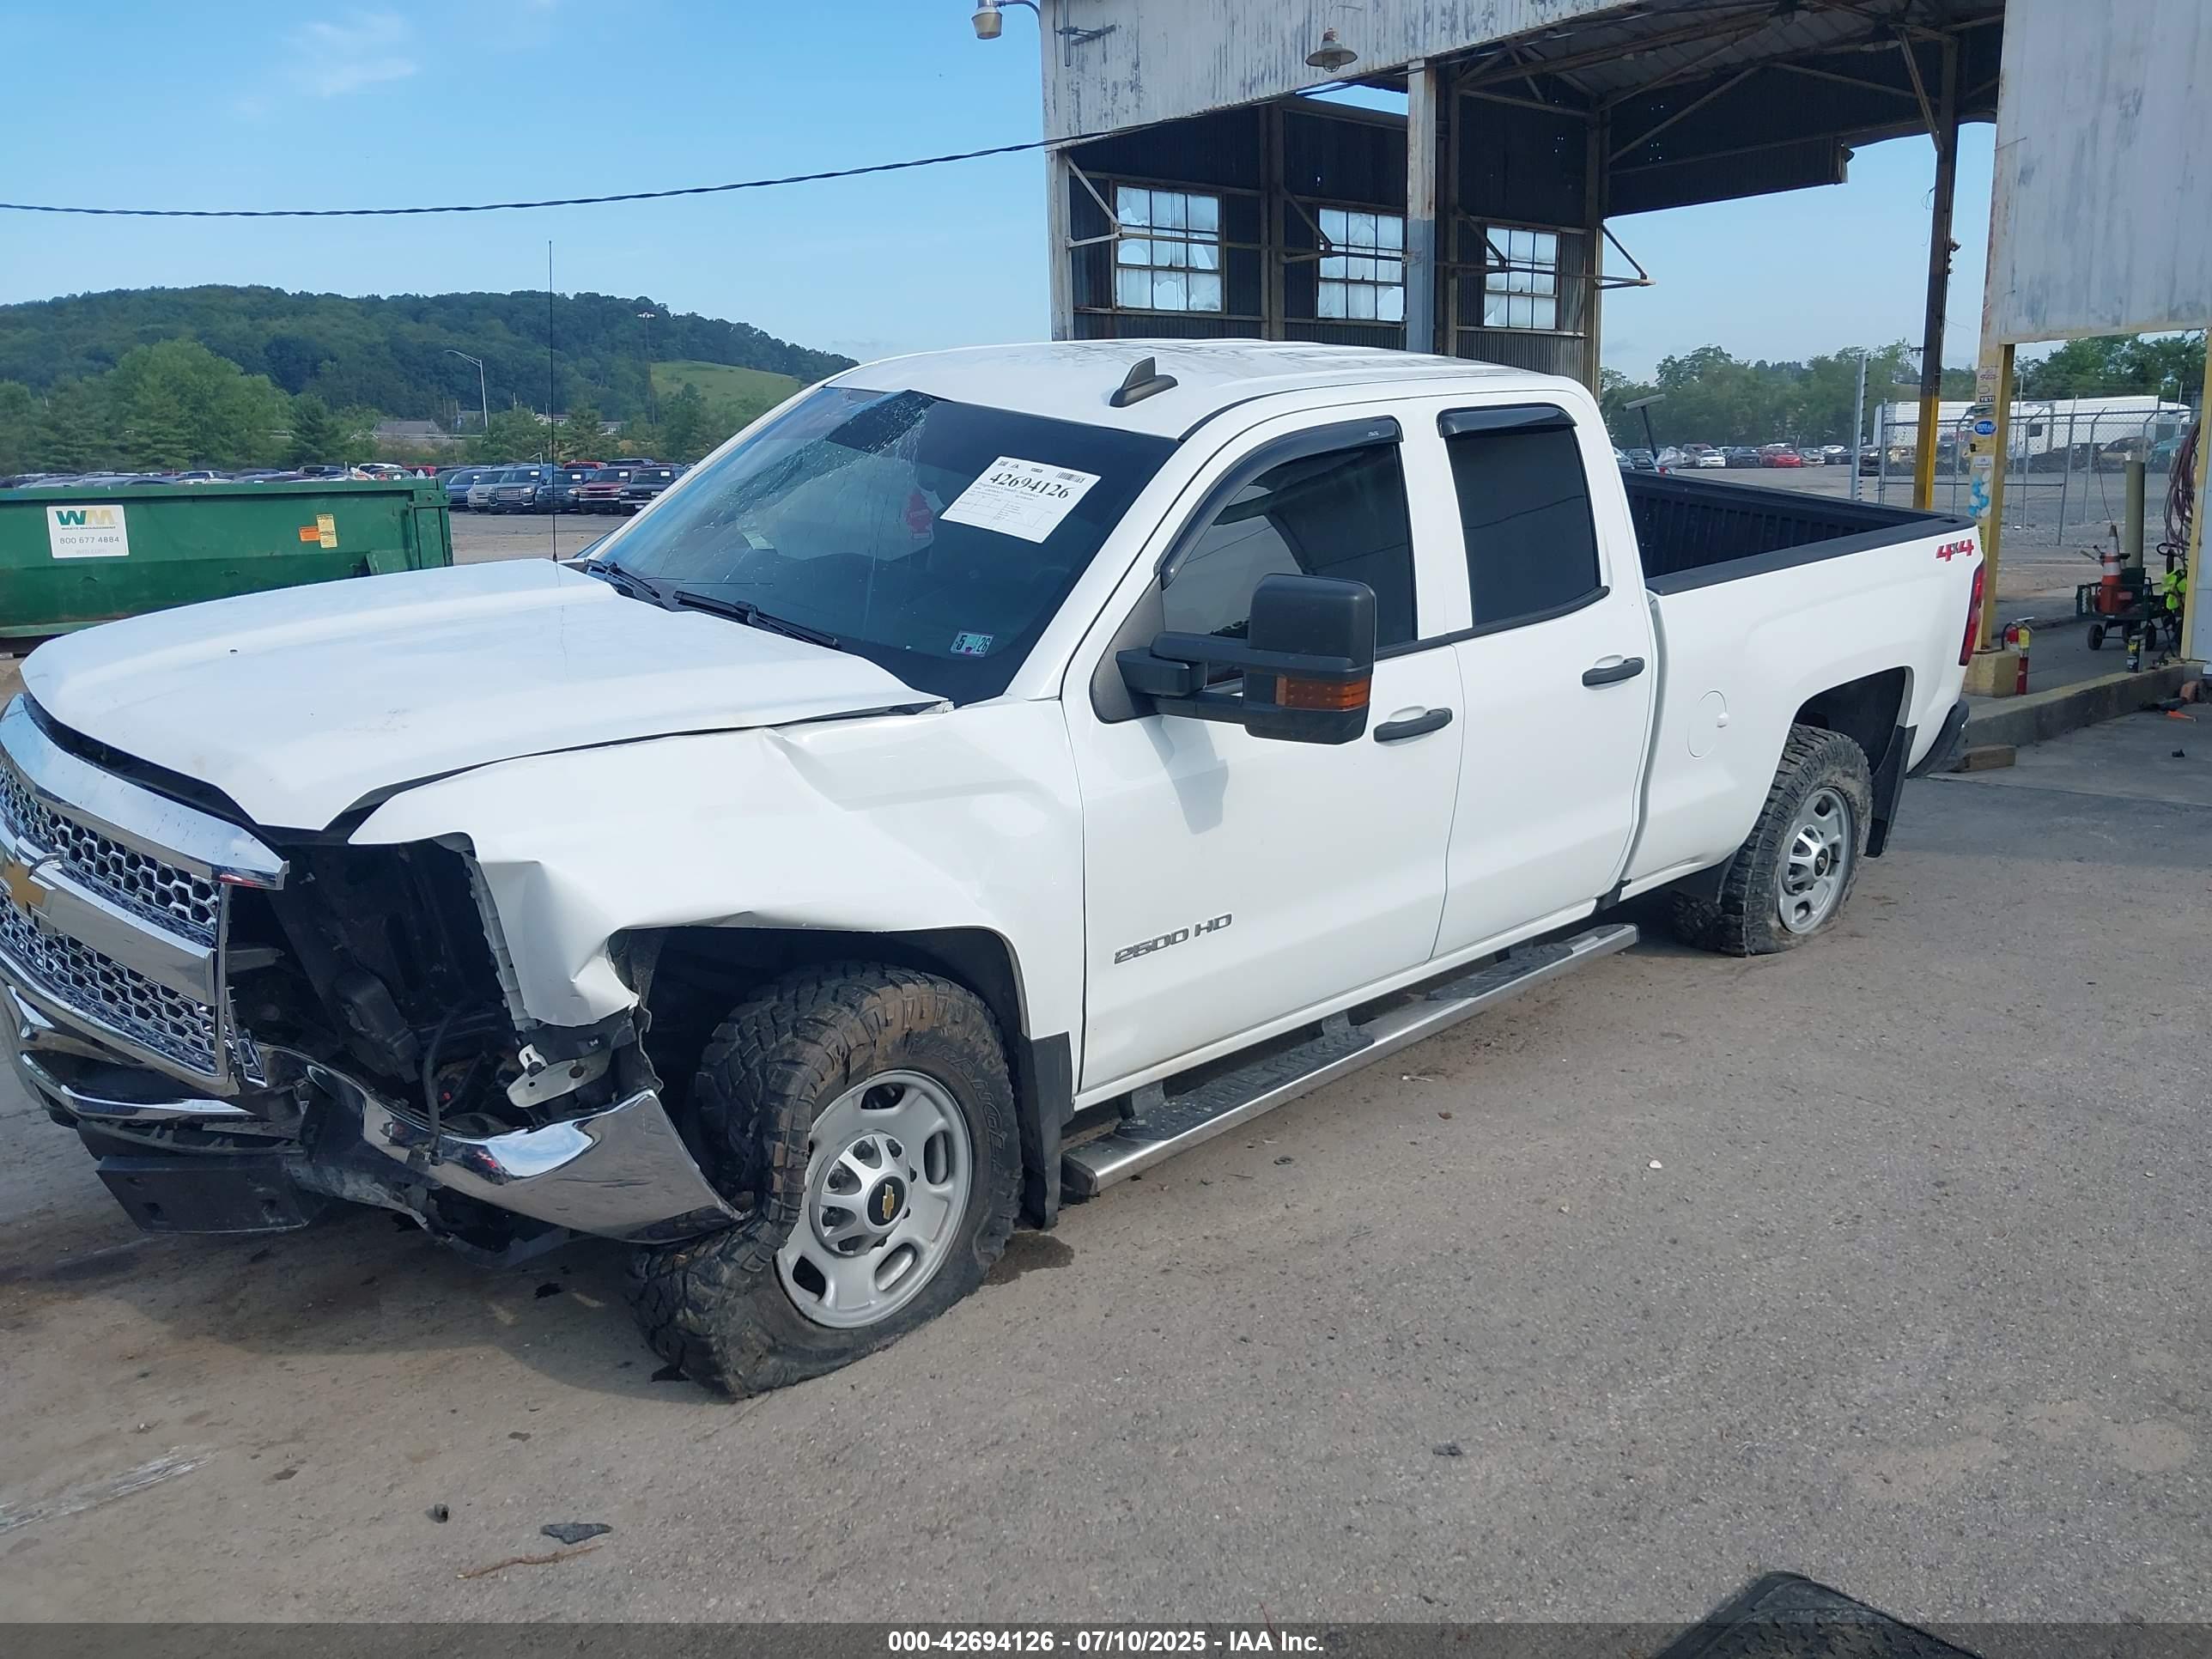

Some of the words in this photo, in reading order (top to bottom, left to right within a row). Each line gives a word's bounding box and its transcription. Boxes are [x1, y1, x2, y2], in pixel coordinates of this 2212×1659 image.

[989, 472, 1075, 500] 42694126
[55, 510, 115, 526] WM
[1114, 927, 1189, 964] 2500
[1194, 913, 1232, 938] HD
